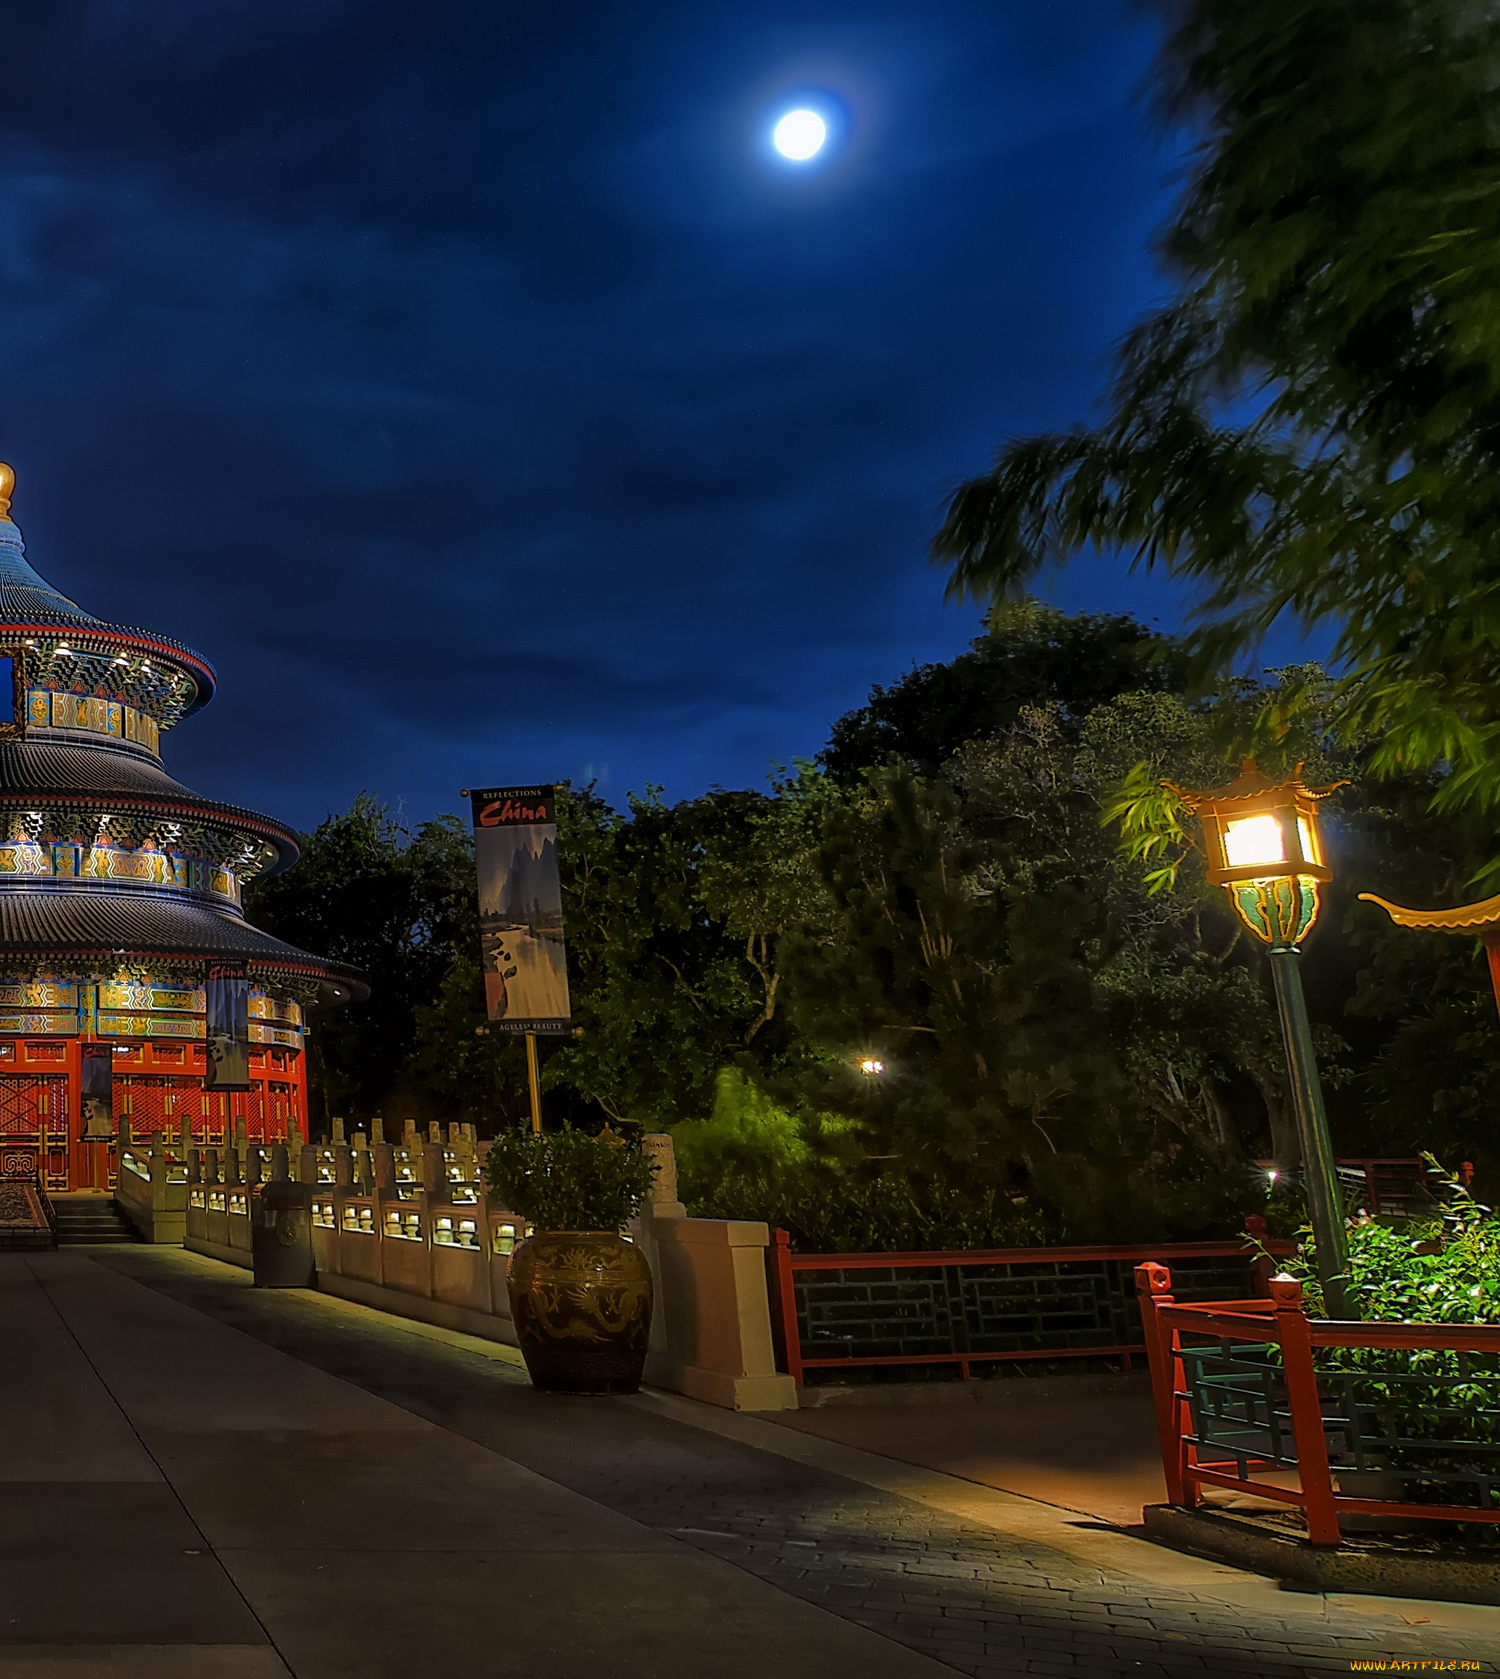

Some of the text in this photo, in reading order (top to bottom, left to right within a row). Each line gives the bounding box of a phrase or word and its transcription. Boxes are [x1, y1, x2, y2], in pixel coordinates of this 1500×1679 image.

[483, 790, 542, 800] REFLECTIONS
[479, 799, 548, 827] China
[533, 1022, 562, 1030] BEAUTY
